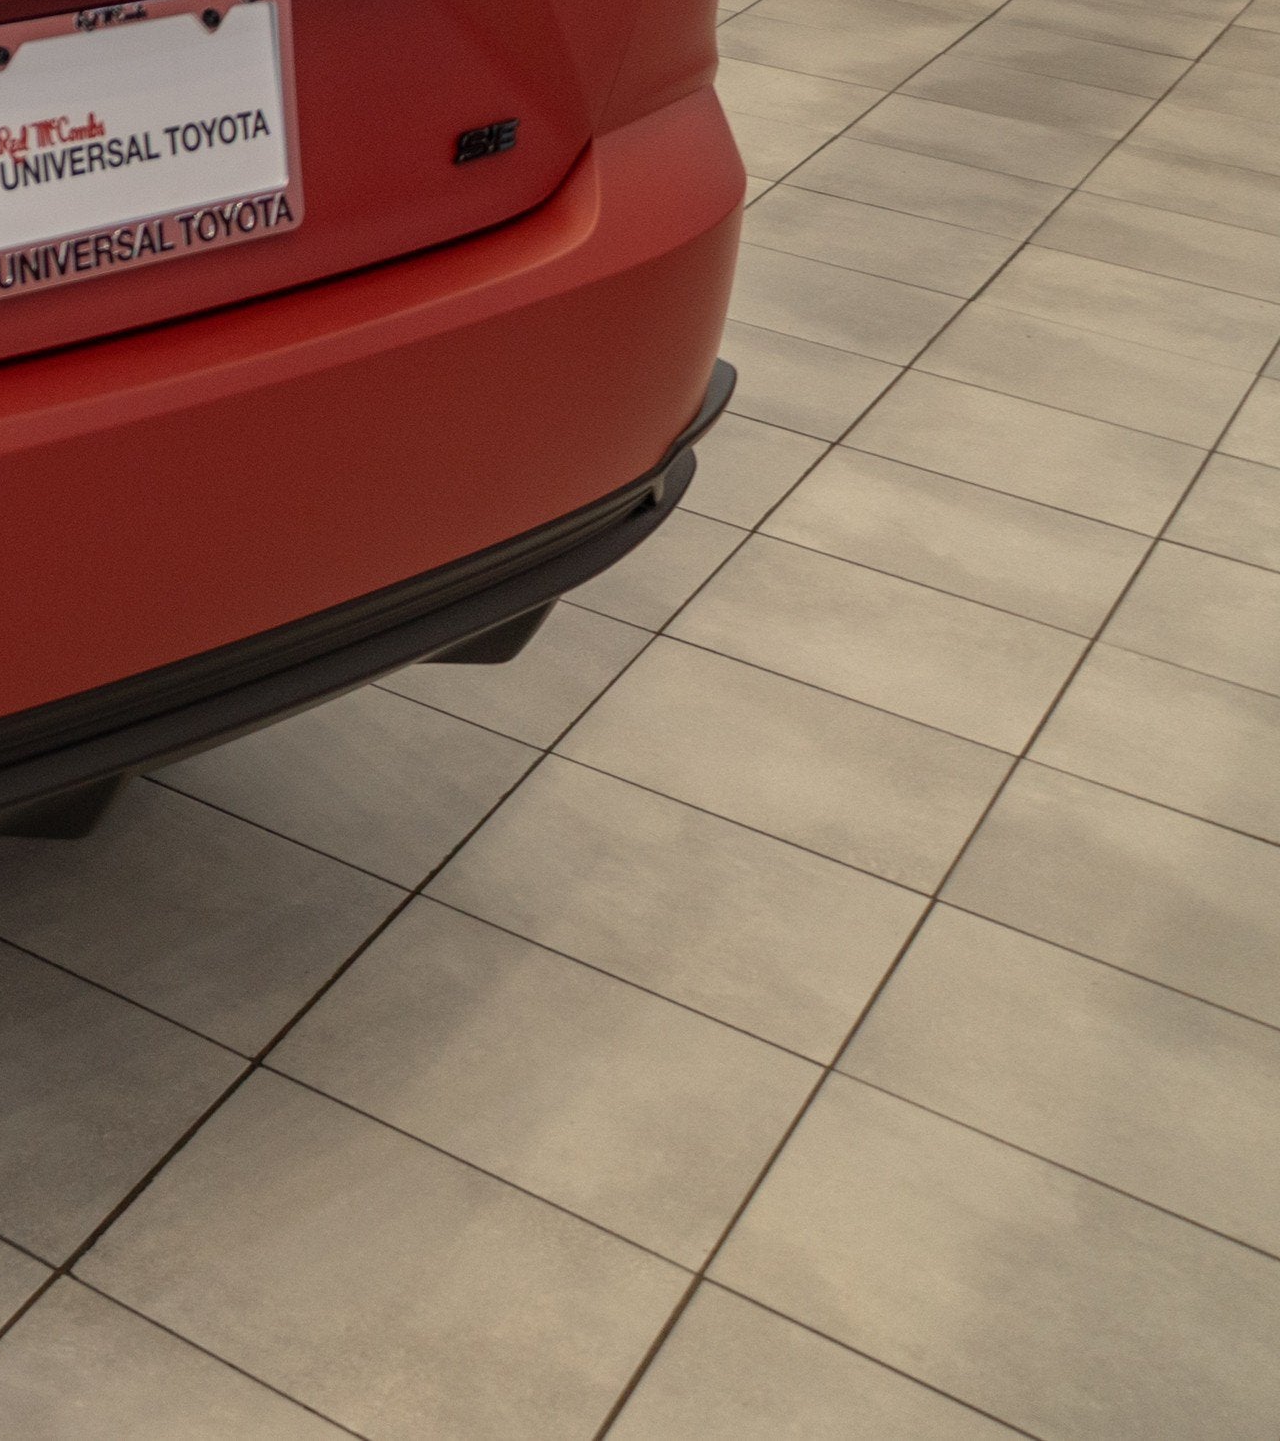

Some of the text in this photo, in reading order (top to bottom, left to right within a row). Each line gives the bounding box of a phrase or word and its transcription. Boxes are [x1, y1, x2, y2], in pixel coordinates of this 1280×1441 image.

[0, 131, 160, 191] UNIVERSAL
[164, 107, 271, 157] TOYOTA
[453, 117, 520, 166] SE
[177, 192, 294, 244] TOYOTA
